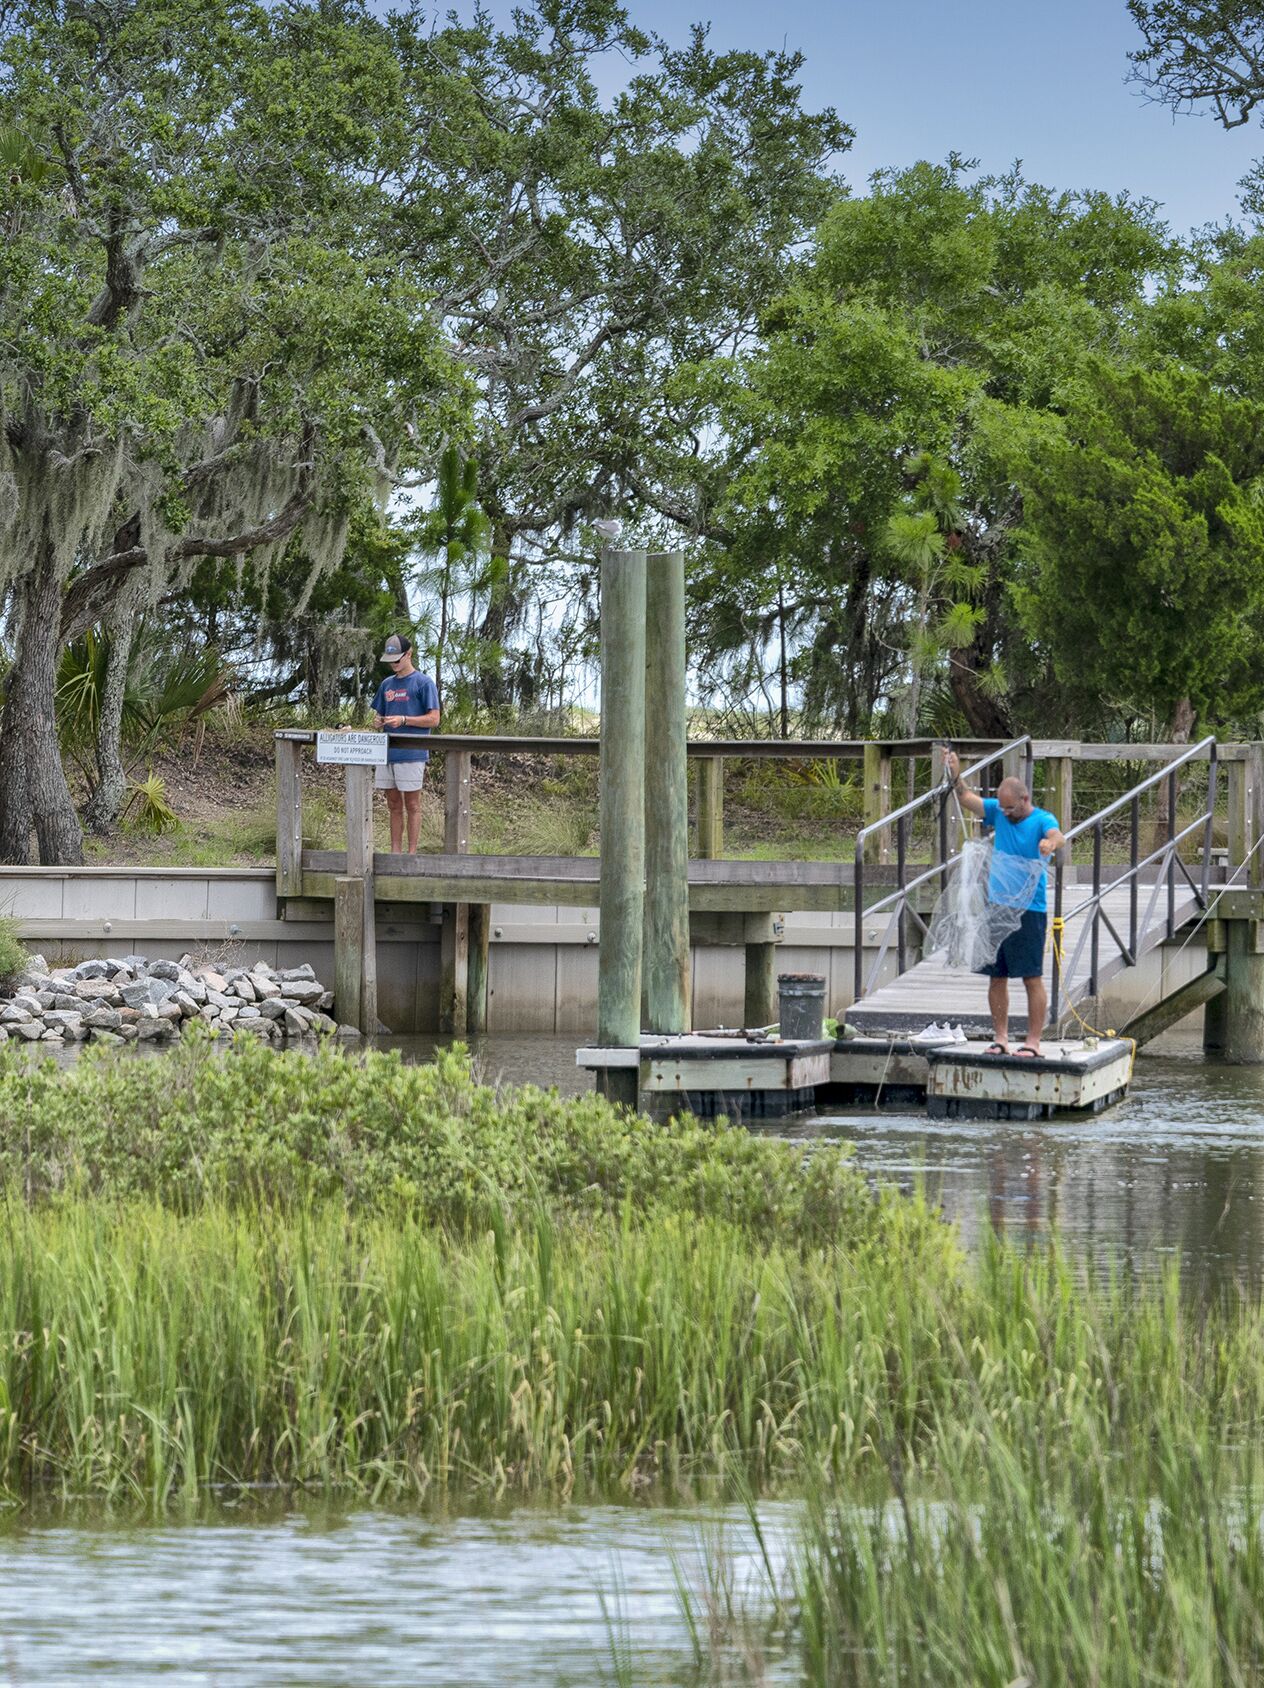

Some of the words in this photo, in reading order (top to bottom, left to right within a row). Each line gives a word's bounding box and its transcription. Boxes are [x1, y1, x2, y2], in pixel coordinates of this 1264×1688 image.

[320, 734, 347, 742] ALLIGATORS
[348, 735, 357, 743] ARE
[358, 735, 386, 744] DANGEROUS
